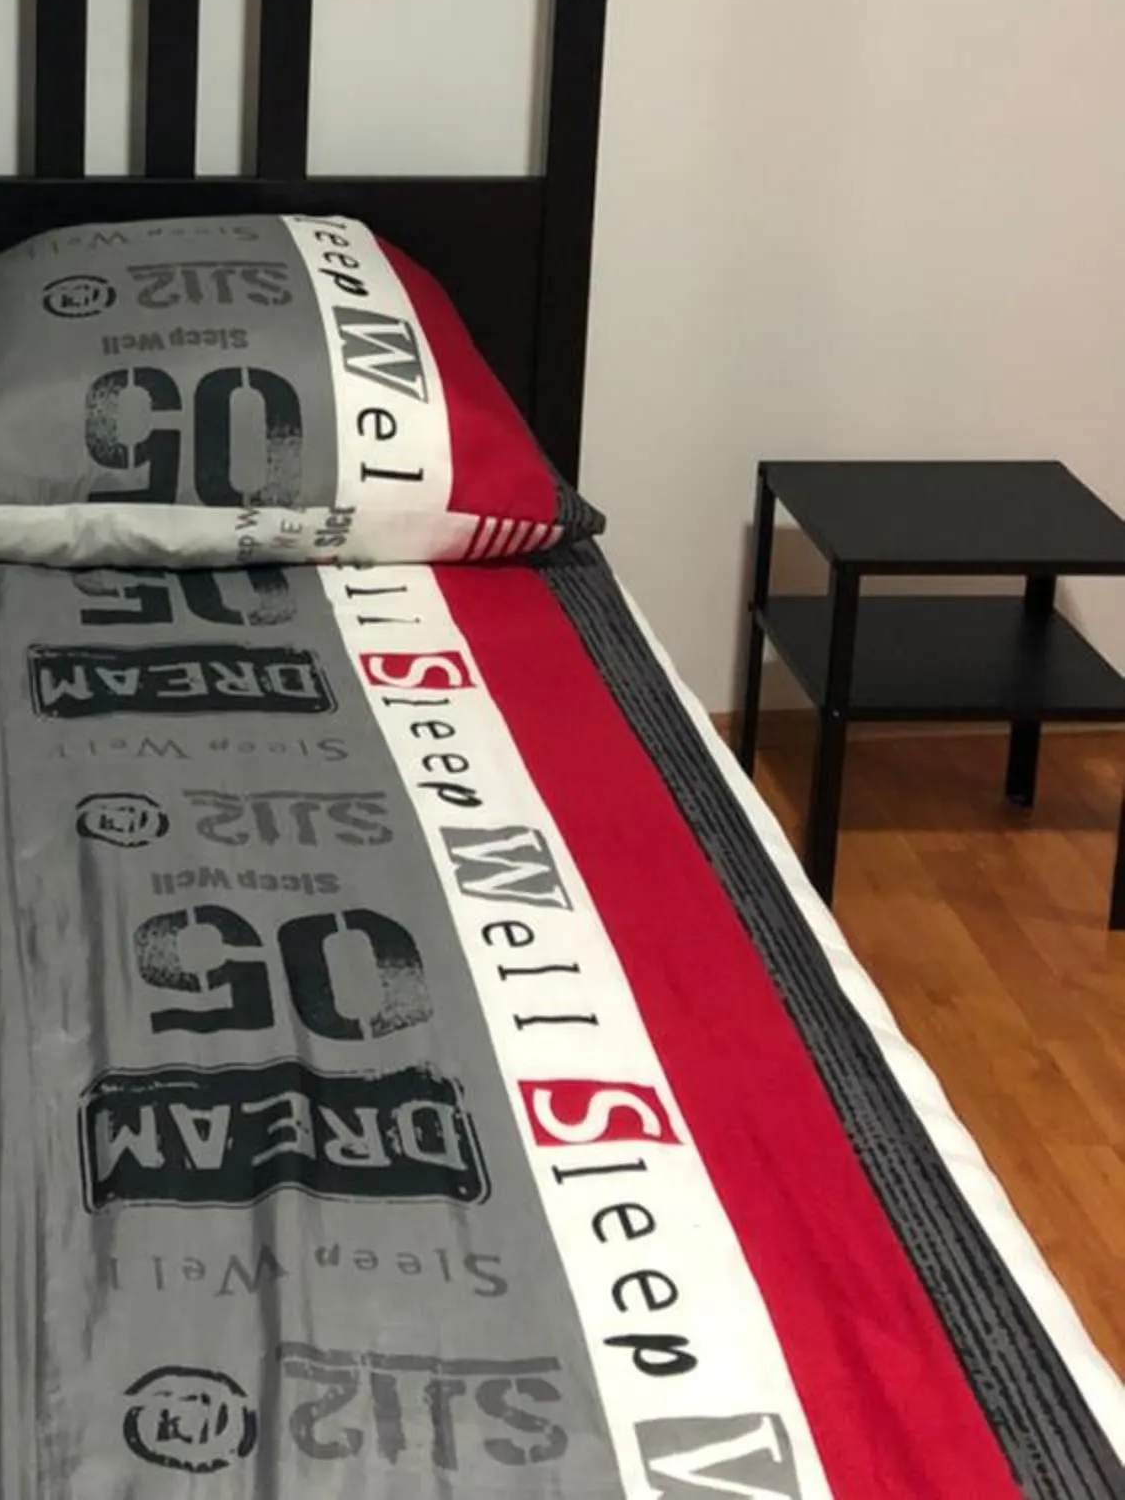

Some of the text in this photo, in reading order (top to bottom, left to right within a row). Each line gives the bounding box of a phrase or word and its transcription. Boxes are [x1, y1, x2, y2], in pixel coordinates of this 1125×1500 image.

[101, 327, 250, 355] Sleep Well
[294, 217, 426, 485] leep Wel
[84, 366, 303, 506] 05
[40, 660, 315, 705] DREAM
[209, 735, 350, 763] Sleep
[151, 866, 341, 896] Sleep Well
[365, 653, 483, 809] Sleep
[445, 827, 599, 1030] Well
[134, 904, 435, 1041] 05
[96, 1090, 469, 1175] DREAM
[109, 1242, 509, 1299] Sleep Well
[532, 1086, 698, 1377] Sleep
